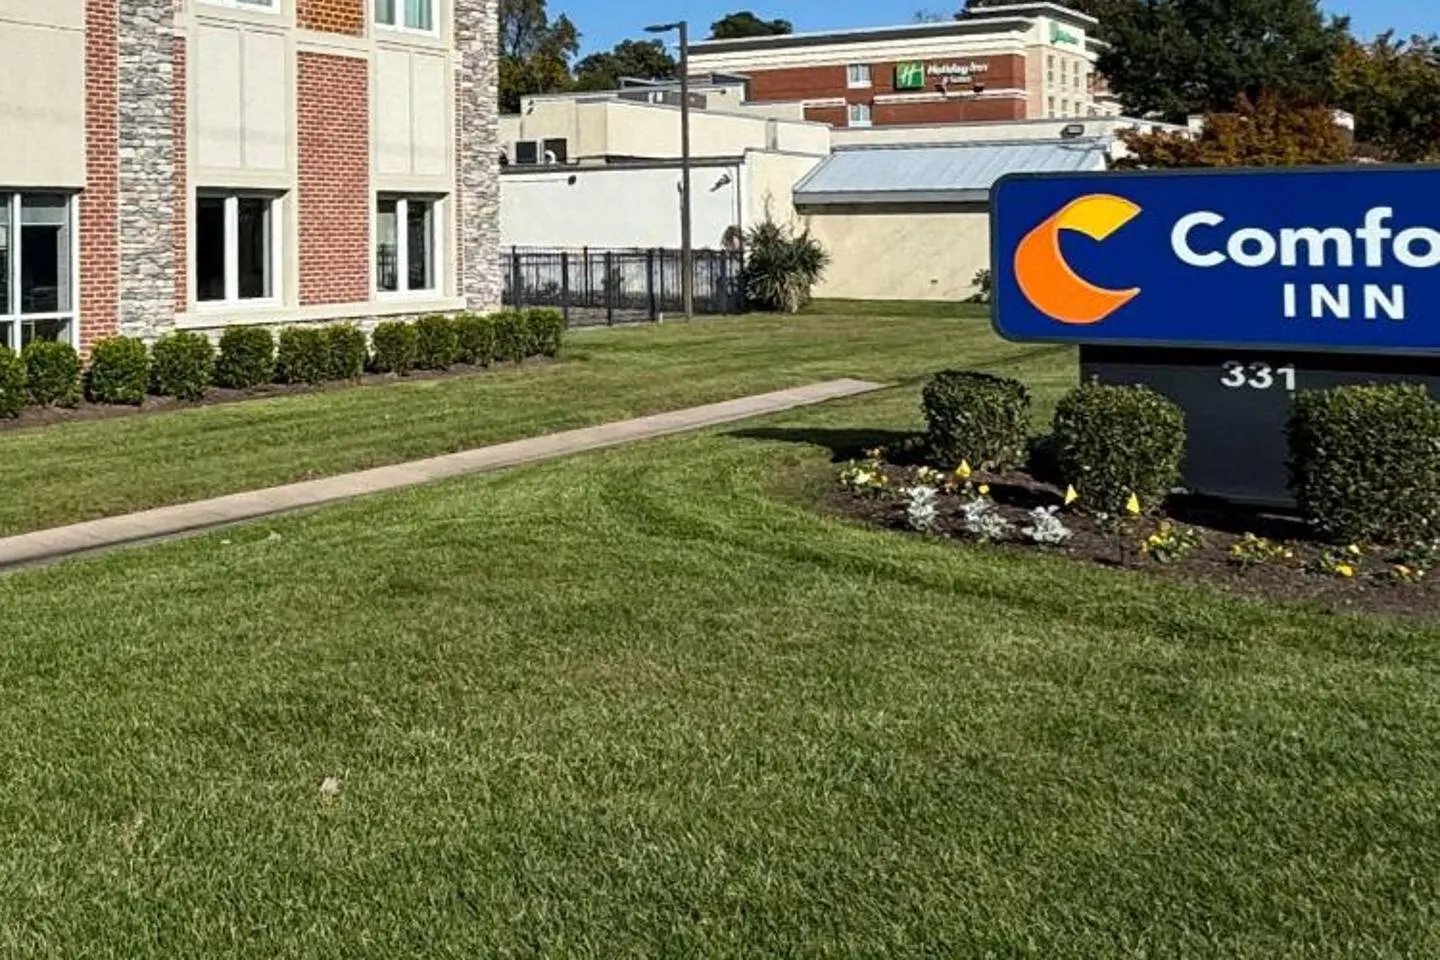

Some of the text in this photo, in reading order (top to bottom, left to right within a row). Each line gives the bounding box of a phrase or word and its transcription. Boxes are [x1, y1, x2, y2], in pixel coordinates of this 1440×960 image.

[1171, 206, 1440, 268] Comfo
[1283, 283, 1405, 320] INN
[1220, 360, 1296, 390] 331
